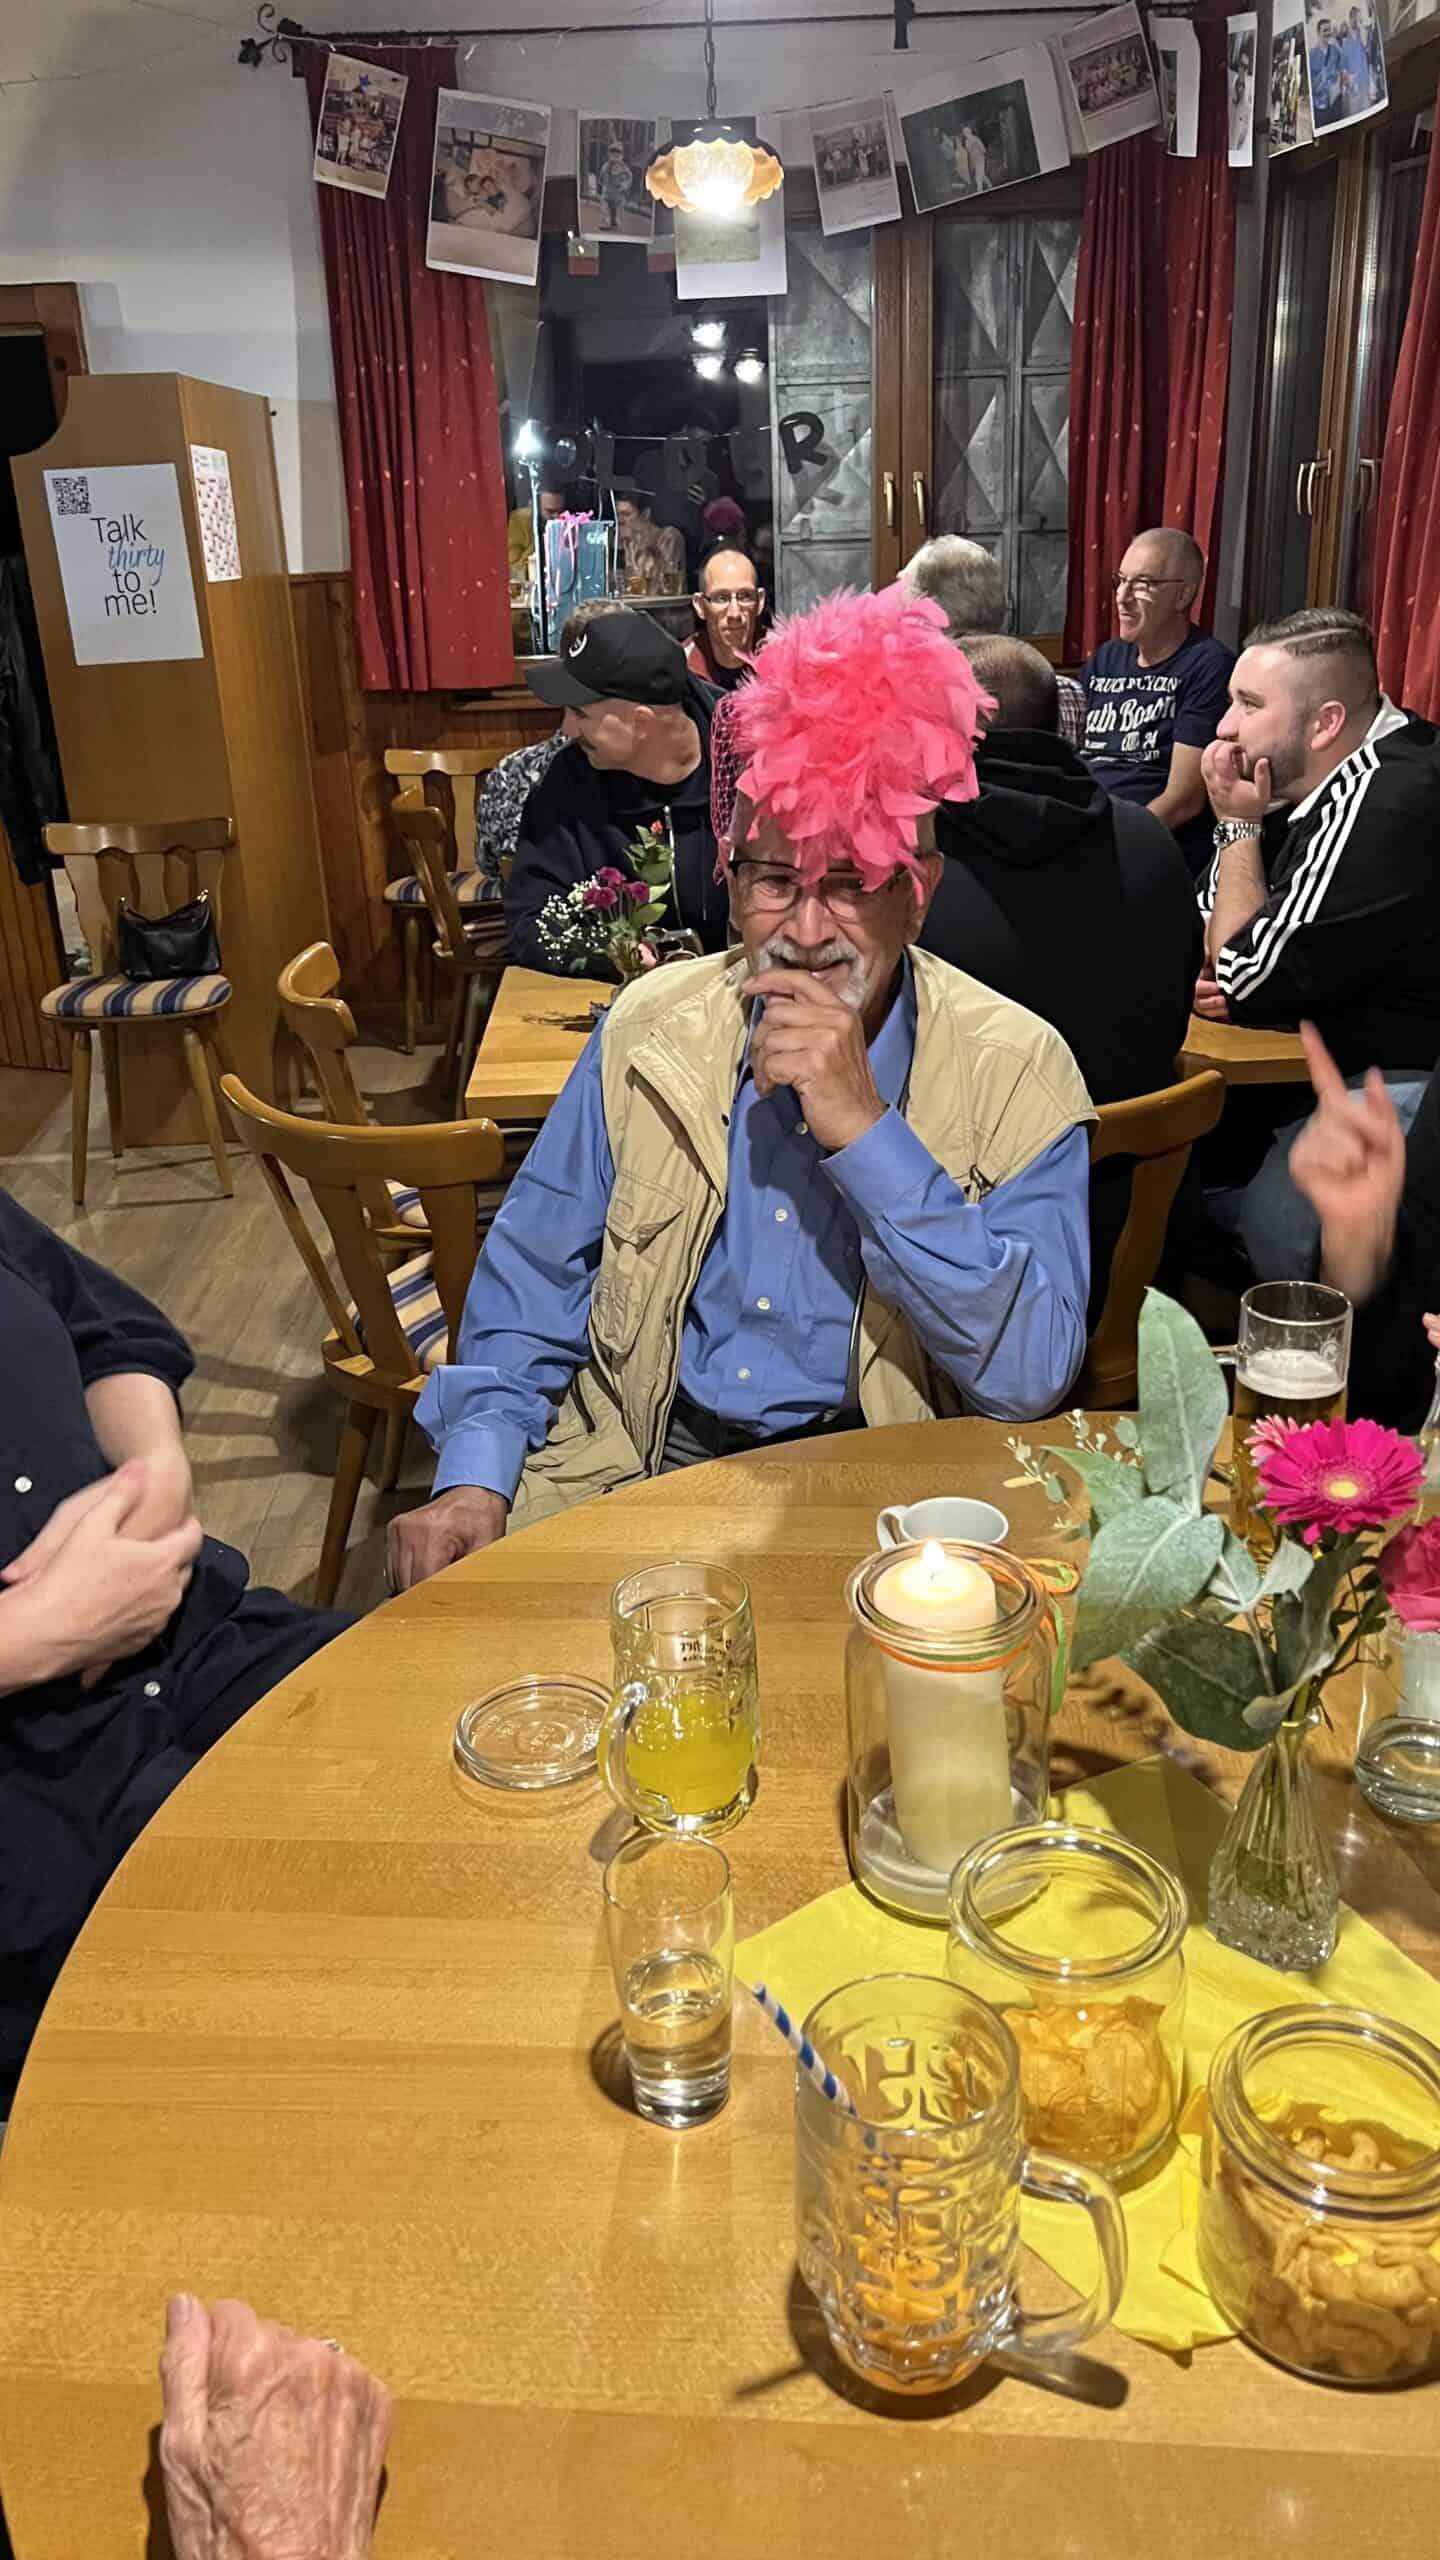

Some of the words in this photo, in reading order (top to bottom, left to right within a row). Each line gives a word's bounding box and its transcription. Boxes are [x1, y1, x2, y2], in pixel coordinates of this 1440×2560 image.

[89, 512, 147, 543] Talk
[108, 536, 165, 587] thirty
[112, 568, 141, 593] to
[104, 588, 157, 617] me!
